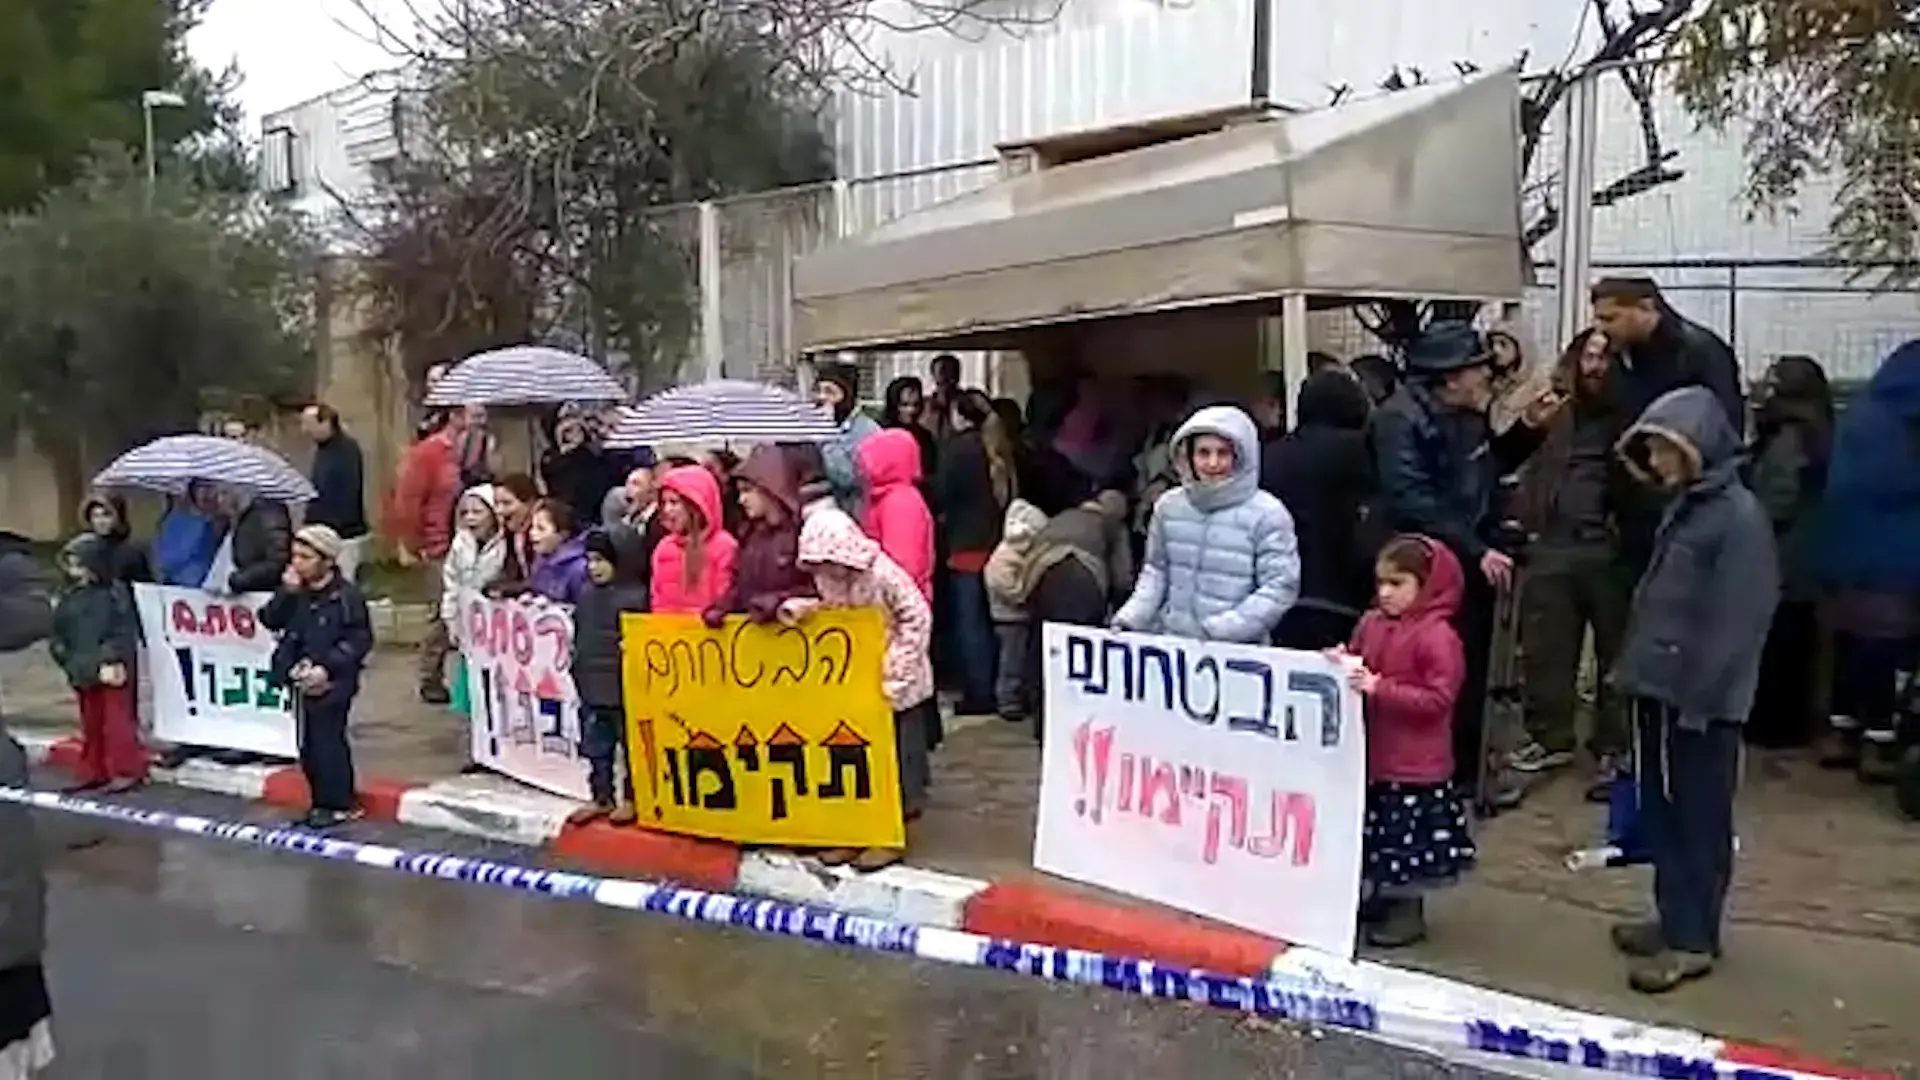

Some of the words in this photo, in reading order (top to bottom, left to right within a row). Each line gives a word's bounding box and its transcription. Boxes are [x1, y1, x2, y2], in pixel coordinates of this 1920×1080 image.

[172, 599, 255, 639] סתם
[470, 601, 569, 667] רסתם
[175, 647, 292, 716] בנו!
[644, 619, 852, 697] הבטחתם
[1067, 635, 1341, 747] הבטחתם
[482, 667, 571, 756] בנו!
